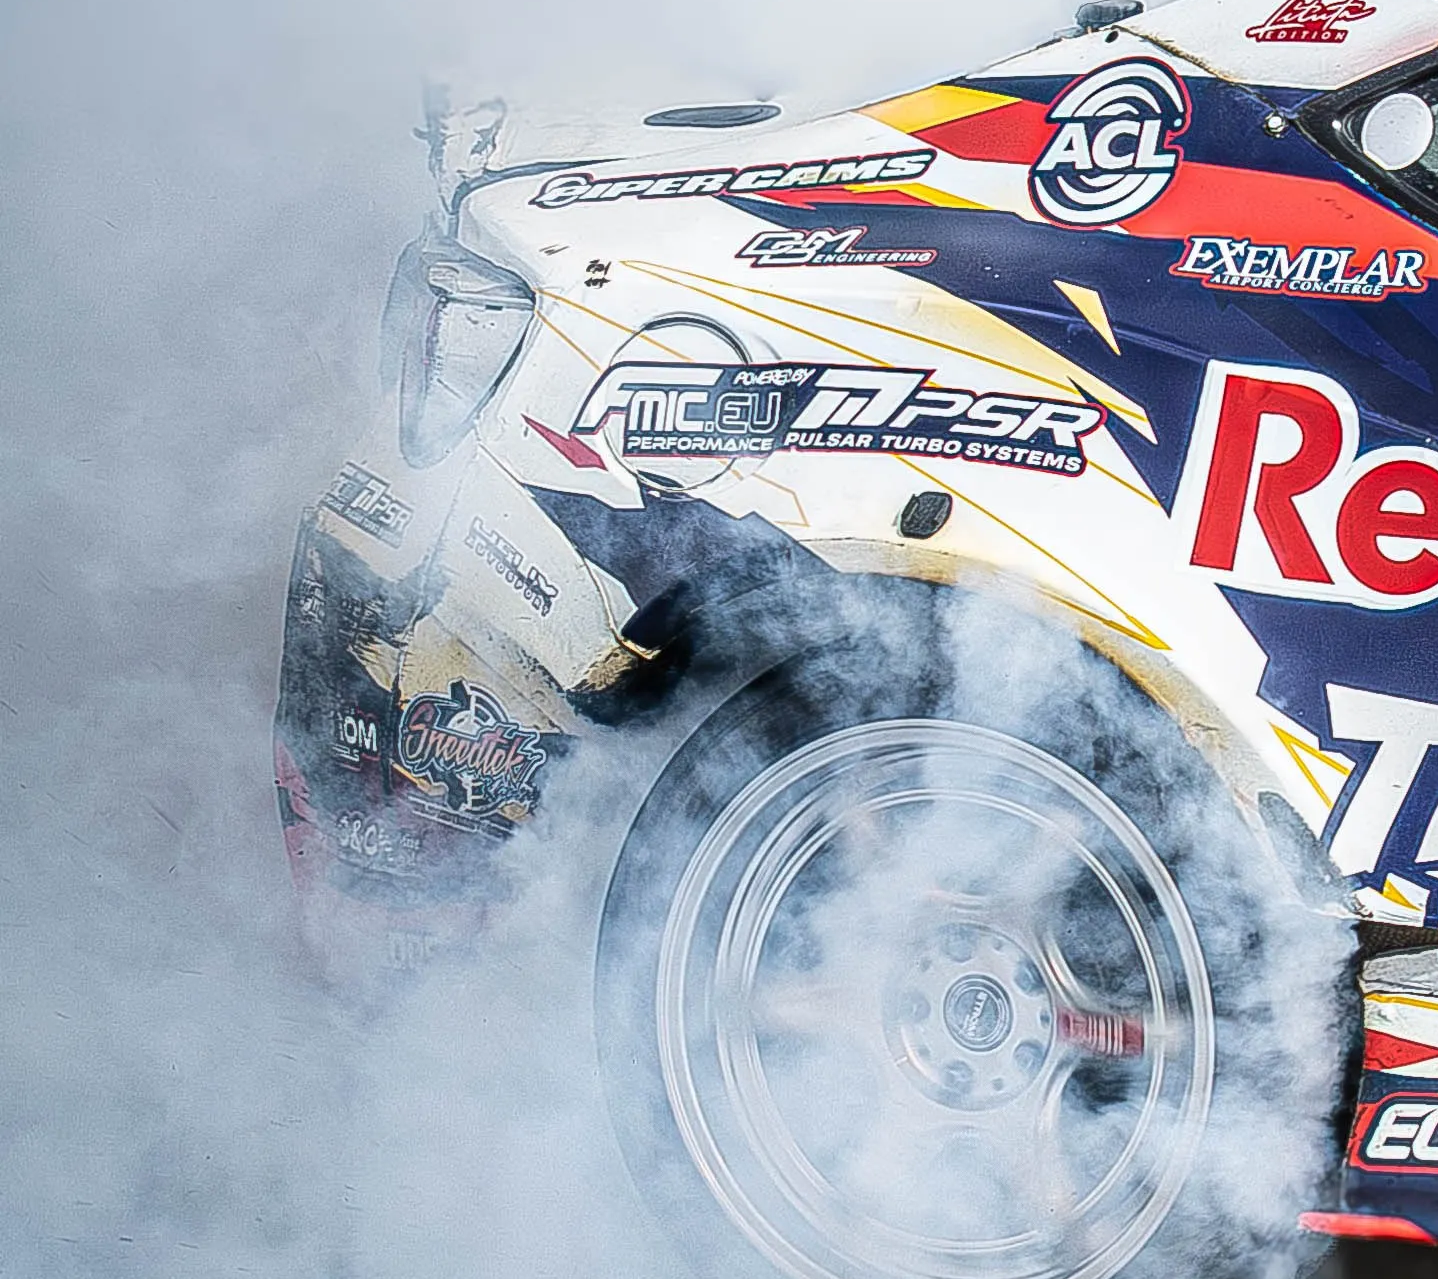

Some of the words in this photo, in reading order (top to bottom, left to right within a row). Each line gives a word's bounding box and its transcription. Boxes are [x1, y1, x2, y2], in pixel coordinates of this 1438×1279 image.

[1264, 29, 1346, 42] EDITION
[1036, 119, 1176, 170] ACL
[729, 152, 933, 192] CAMS
[812, 250, 933, 264] ENGINEERING
[1178, 237, 1423, 288] EXEMPLAR
[1210, 274, 1284, 289] AIRPORT
[1289, 280, 1383, 297] CONCIERGE
[627, 435, 773, 452] PERFORMANCE
[783, 432, 871, 450] PULSAR
[881, 435, 959, 456] TURBO
[963, 441, 1082, 473] SYSTEMS
